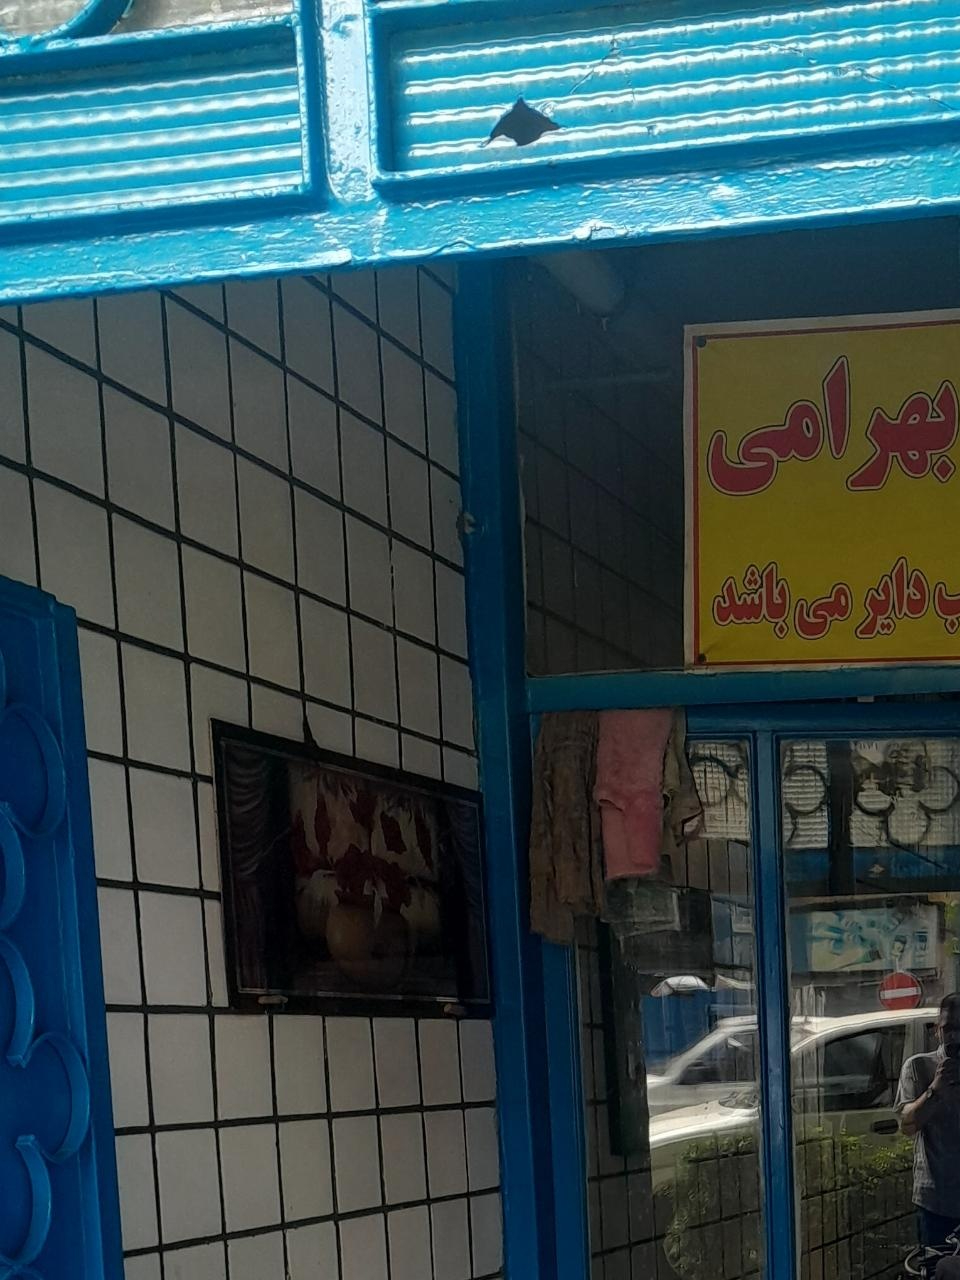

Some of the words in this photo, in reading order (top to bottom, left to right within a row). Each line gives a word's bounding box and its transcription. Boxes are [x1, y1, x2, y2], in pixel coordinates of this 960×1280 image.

[707, 356, 959, 496] بهرامی
[712, 561, 791, 639] باشد
[794, 582, 852, 640] می
[855, 556, 929, 639] دایر
